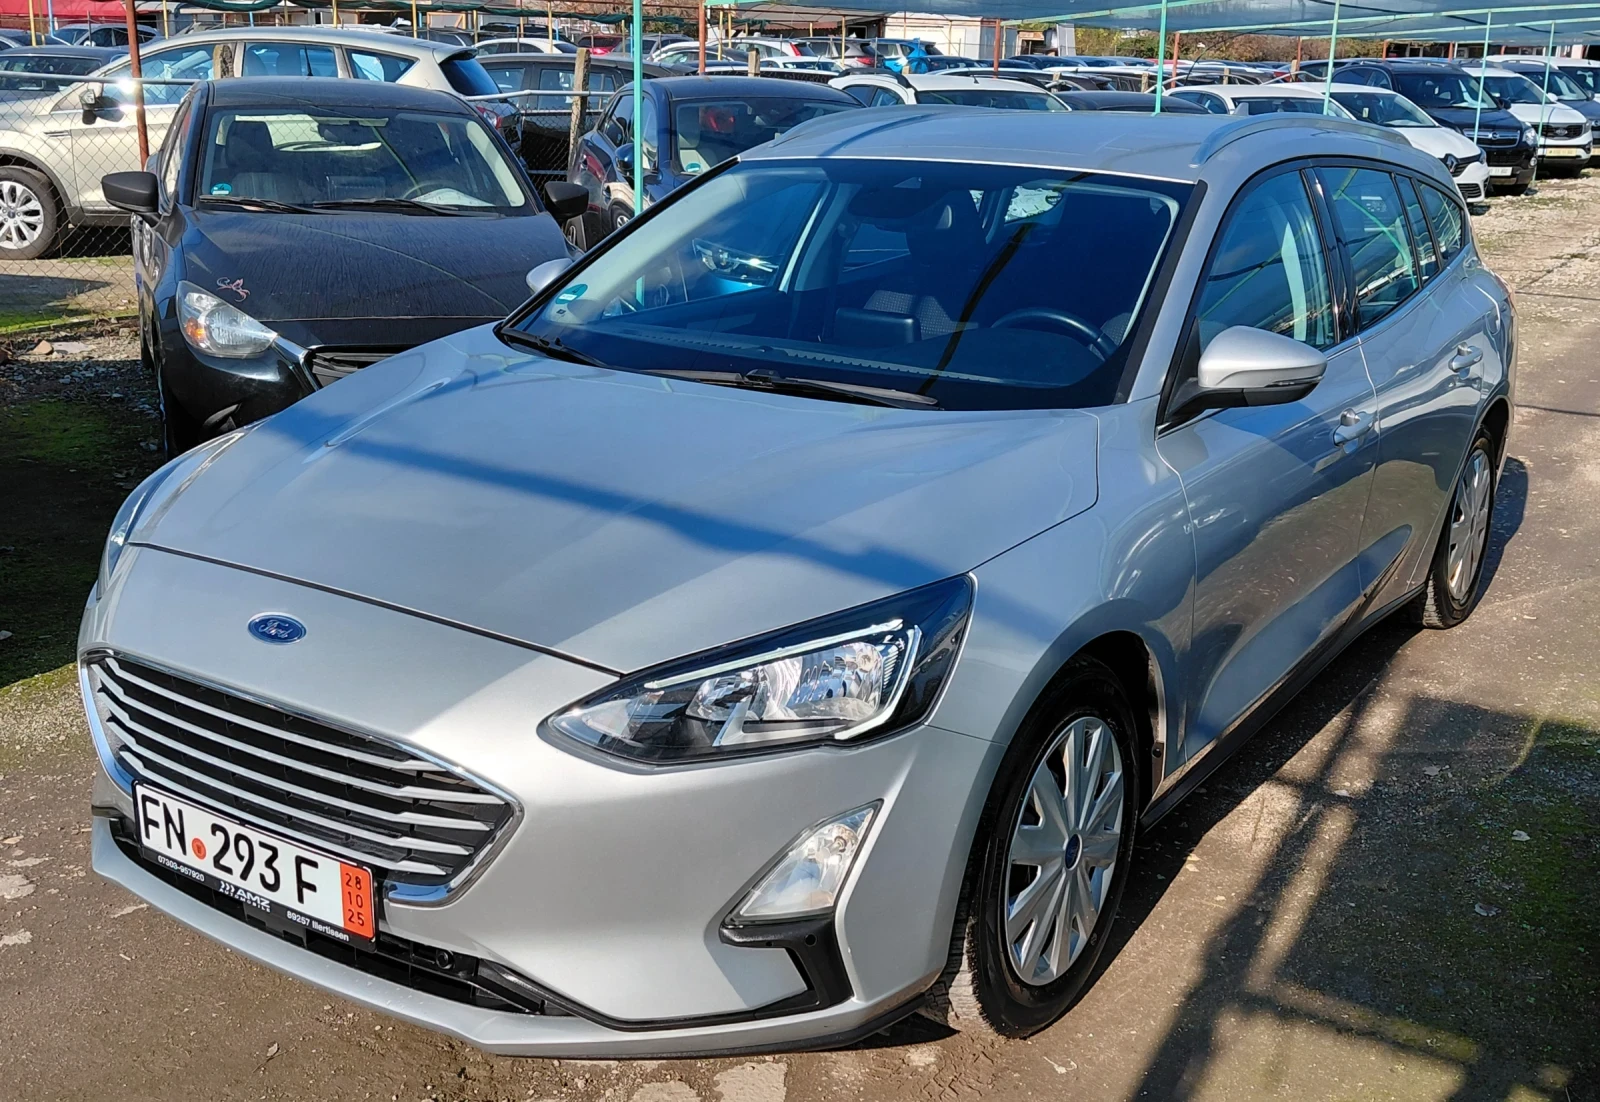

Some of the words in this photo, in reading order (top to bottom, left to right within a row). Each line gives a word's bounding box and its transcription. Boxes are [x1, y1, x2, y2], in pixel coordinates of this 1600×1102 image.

[258, 619, 294, 639] Ford
[141, 794, 187, 856] FN
[210, 823, 281, 893] 293
[294, 855, 319, 905] F
[157, 855, 205, 882] 07303-957920
[345, 872, 362, 890] 28
[236, 888, 270, 908] AMZ
[347, 891, 364, 908] 10
[285, 910, 311, 926] 89257
[347, 908, 365, 927] 25
